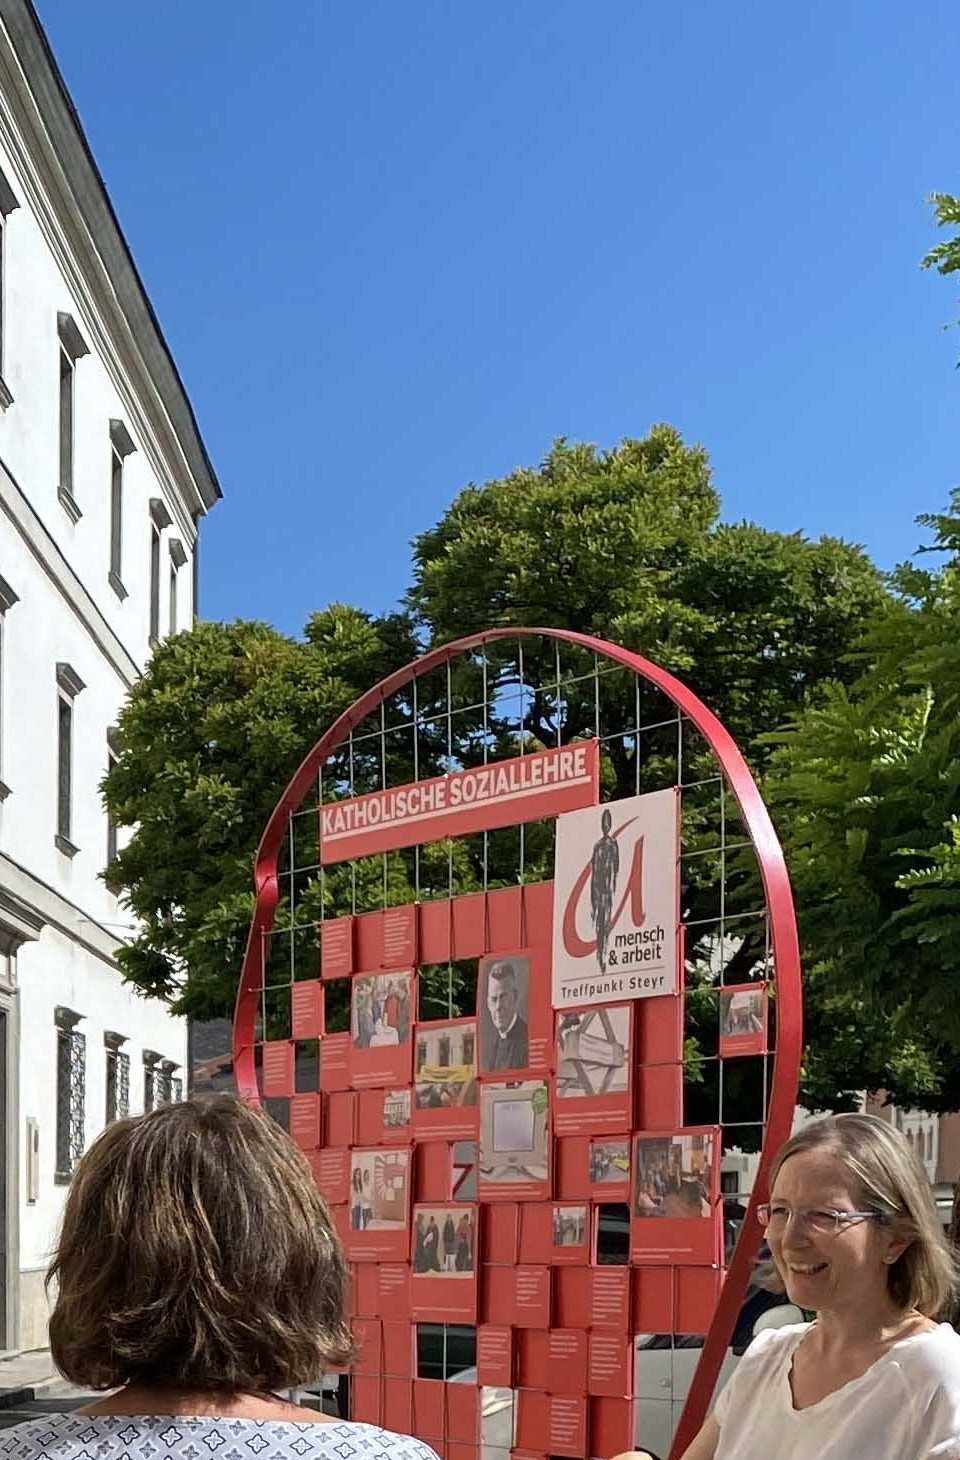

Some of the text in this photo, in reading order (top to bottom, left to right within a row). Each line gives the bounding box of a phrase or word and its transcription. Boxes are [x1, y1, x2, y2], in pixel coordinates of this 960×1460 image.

[322, 748, 587, 835] KATHOLISCHE SOZIALLEHRE
[615, 925, 665, 948] mensch
[608, 943, 662, 966] & arbeit
[561, 975, 665, 999] Treffpunkt Steyr
